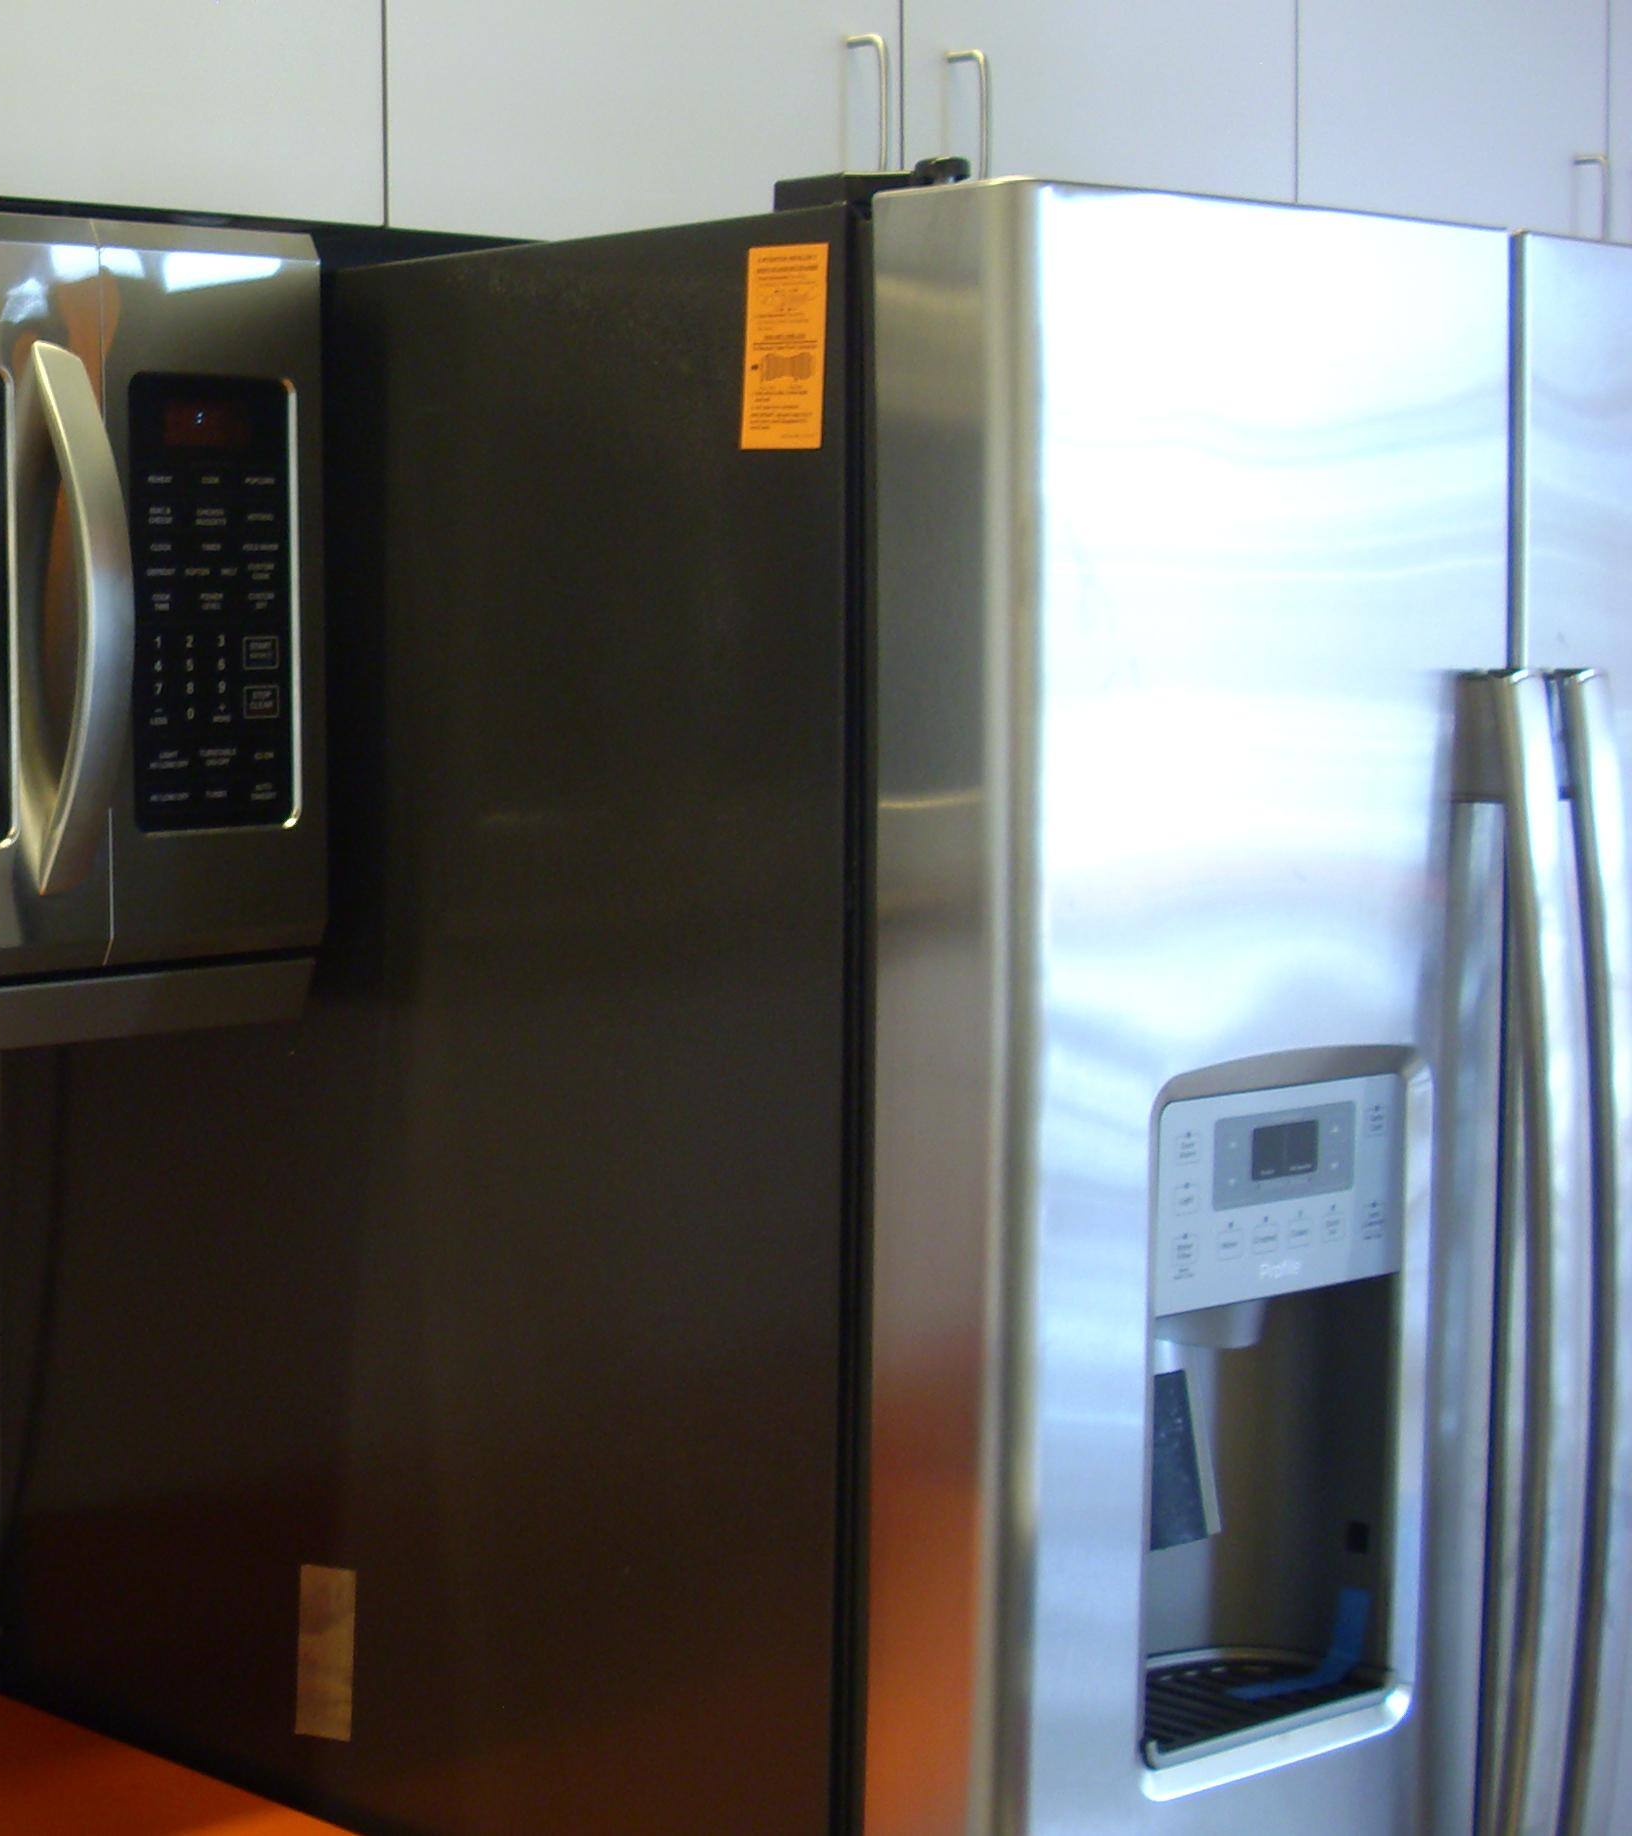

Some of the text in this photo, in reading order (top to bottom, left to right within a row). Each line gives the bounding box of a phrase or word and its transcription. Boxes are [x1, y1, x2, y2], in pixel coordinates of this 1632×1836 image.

[154, 634, 226, 649] 1 2 3
[154, 658, 226, 672] 4 5 6
[155, 680, 227, 695] 7 8 9
[186, 706, 195, 720] 0
